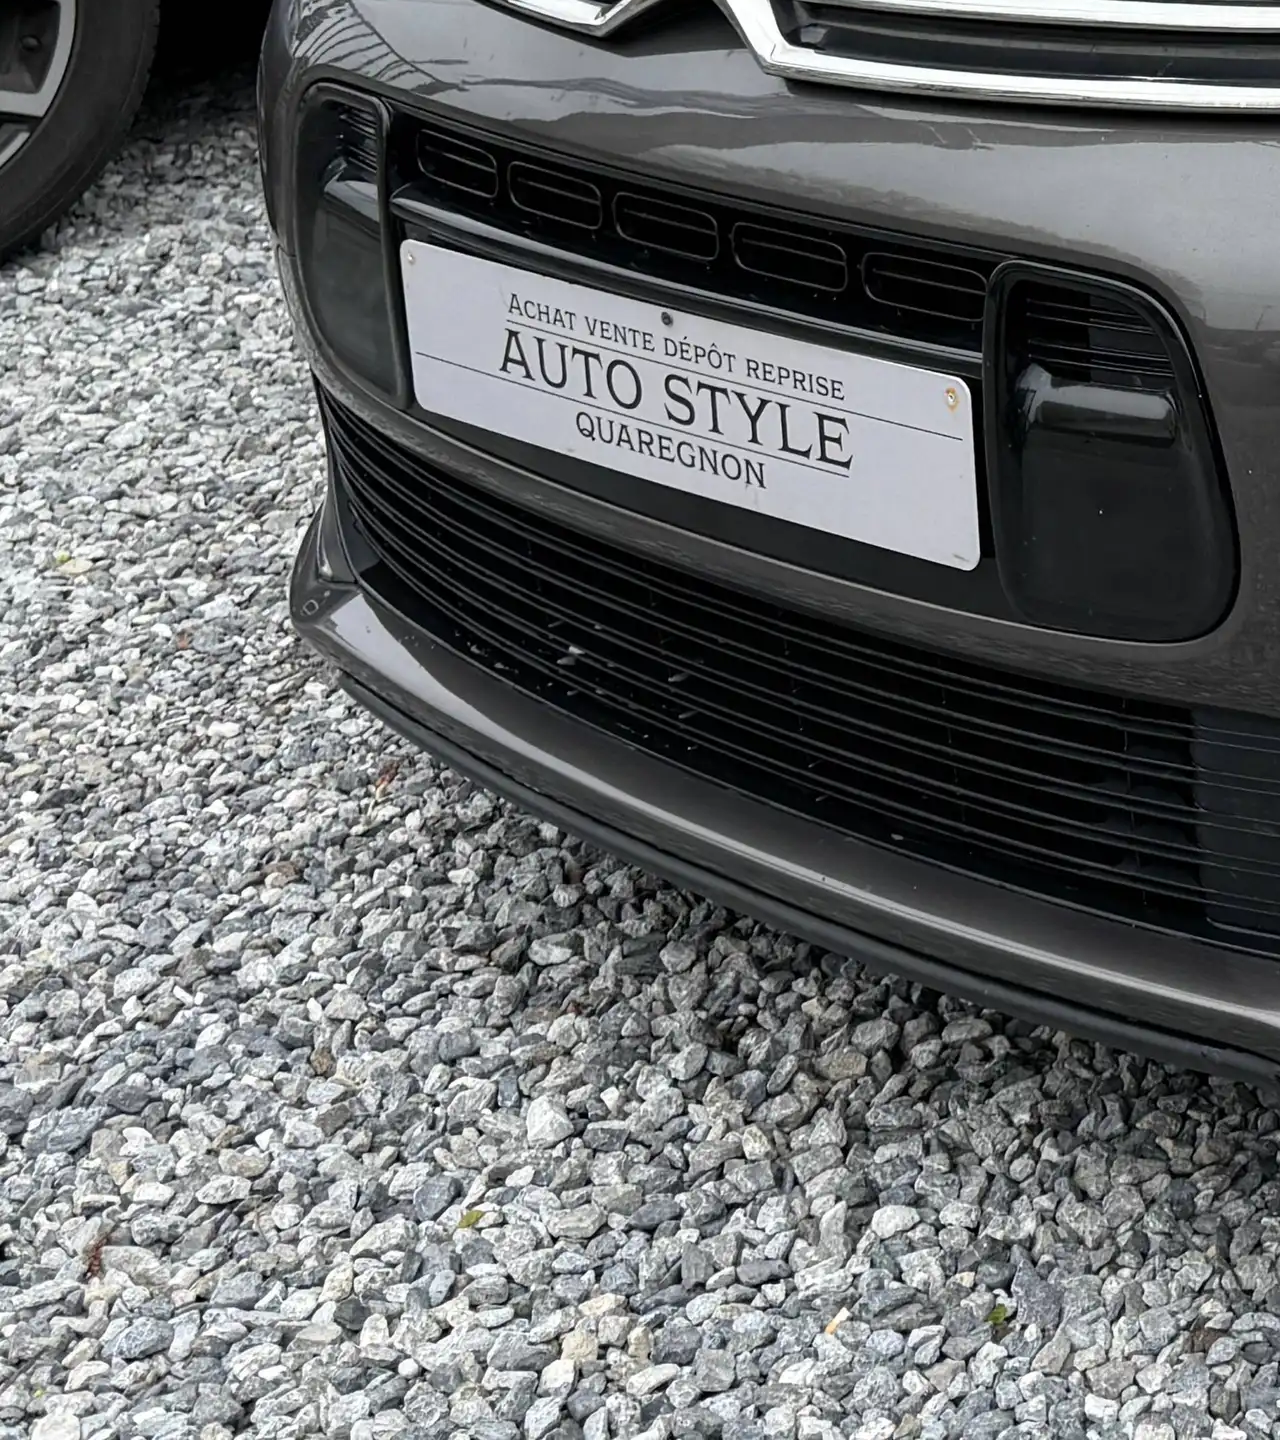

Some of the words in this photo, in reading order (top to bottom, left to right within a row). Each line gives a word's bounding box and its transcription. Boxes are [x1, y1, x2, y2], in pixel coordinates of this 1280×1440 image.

[499, 328, 642, 410] AUTO
[663, 373, 854, 470] STYLE
[508, 293, 576, 331] ACHAT
[584, 315, 655, 352] VENTE
[663, 336, 737, 373] DÉPÔT
[746, 358, 846, 401] REPRISE
[575, 411, 767, 489] QUAREGNON
